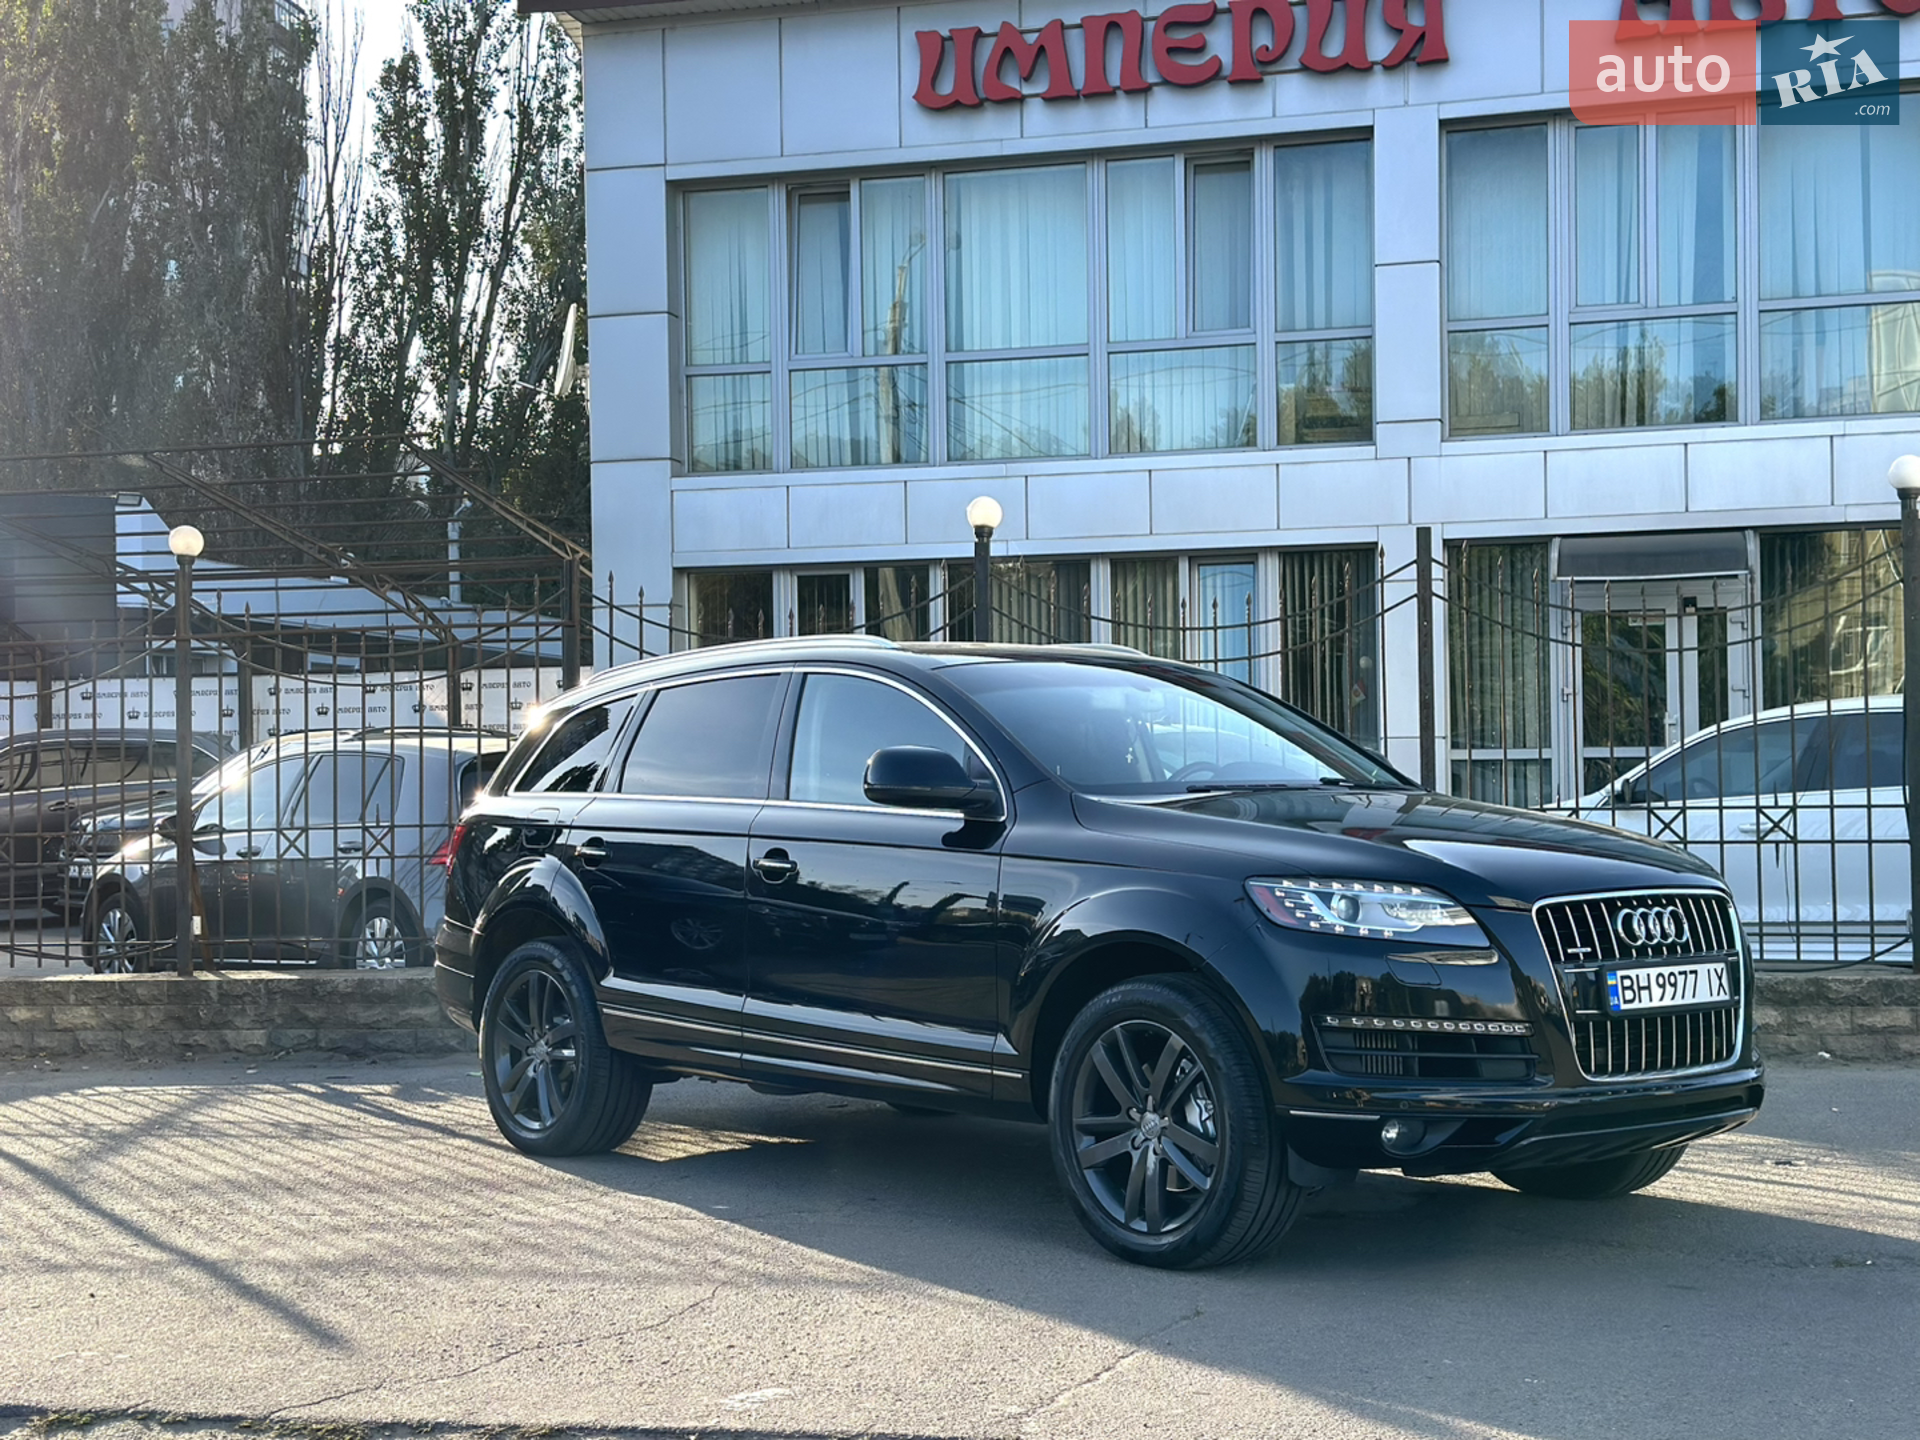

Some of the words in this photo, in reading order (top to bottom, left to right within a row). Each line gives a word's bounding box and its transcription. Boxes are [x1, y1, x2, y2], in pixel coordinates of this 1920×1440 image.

[912, 0, 1449, 110] ИМПЕРИЯ
[1620, 973, 1653, 1005] BH
[1655, 969, 1698, 1002] 9977
[1707, 967, 1728, 997] IX
